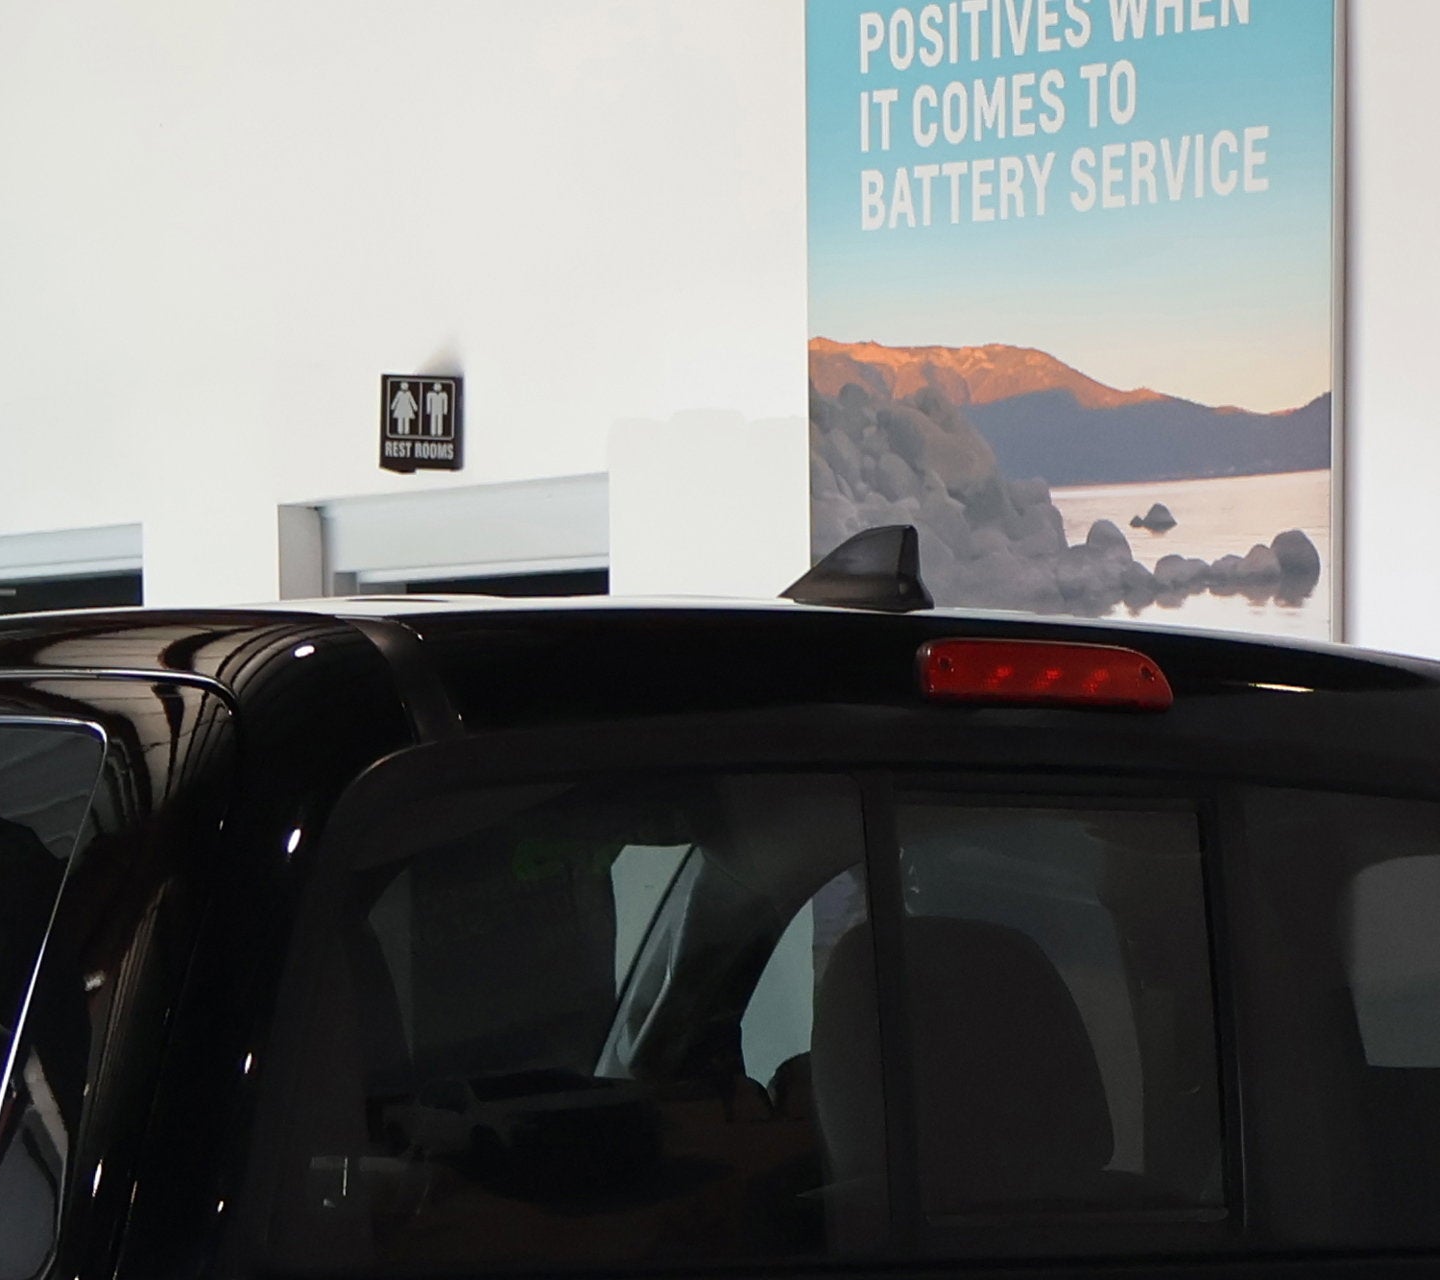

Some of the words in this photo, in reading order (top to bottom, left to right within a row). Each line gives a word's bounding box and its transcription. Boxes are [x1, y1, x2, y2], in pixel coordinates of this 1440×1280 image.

[860, 0, 1092, 75] POSITIVES
[860, 88, 899, 153] IT
[912, 68, 1066, 149] COMES
[1080, 59, 1137, 129] TO
[861, 151, 1057, 232] BATTERY
[1070, 125, 1270, 213] SERVICE
[384, 441, 413, 458] REST
[414, 442, 455, 460] ROOMS
